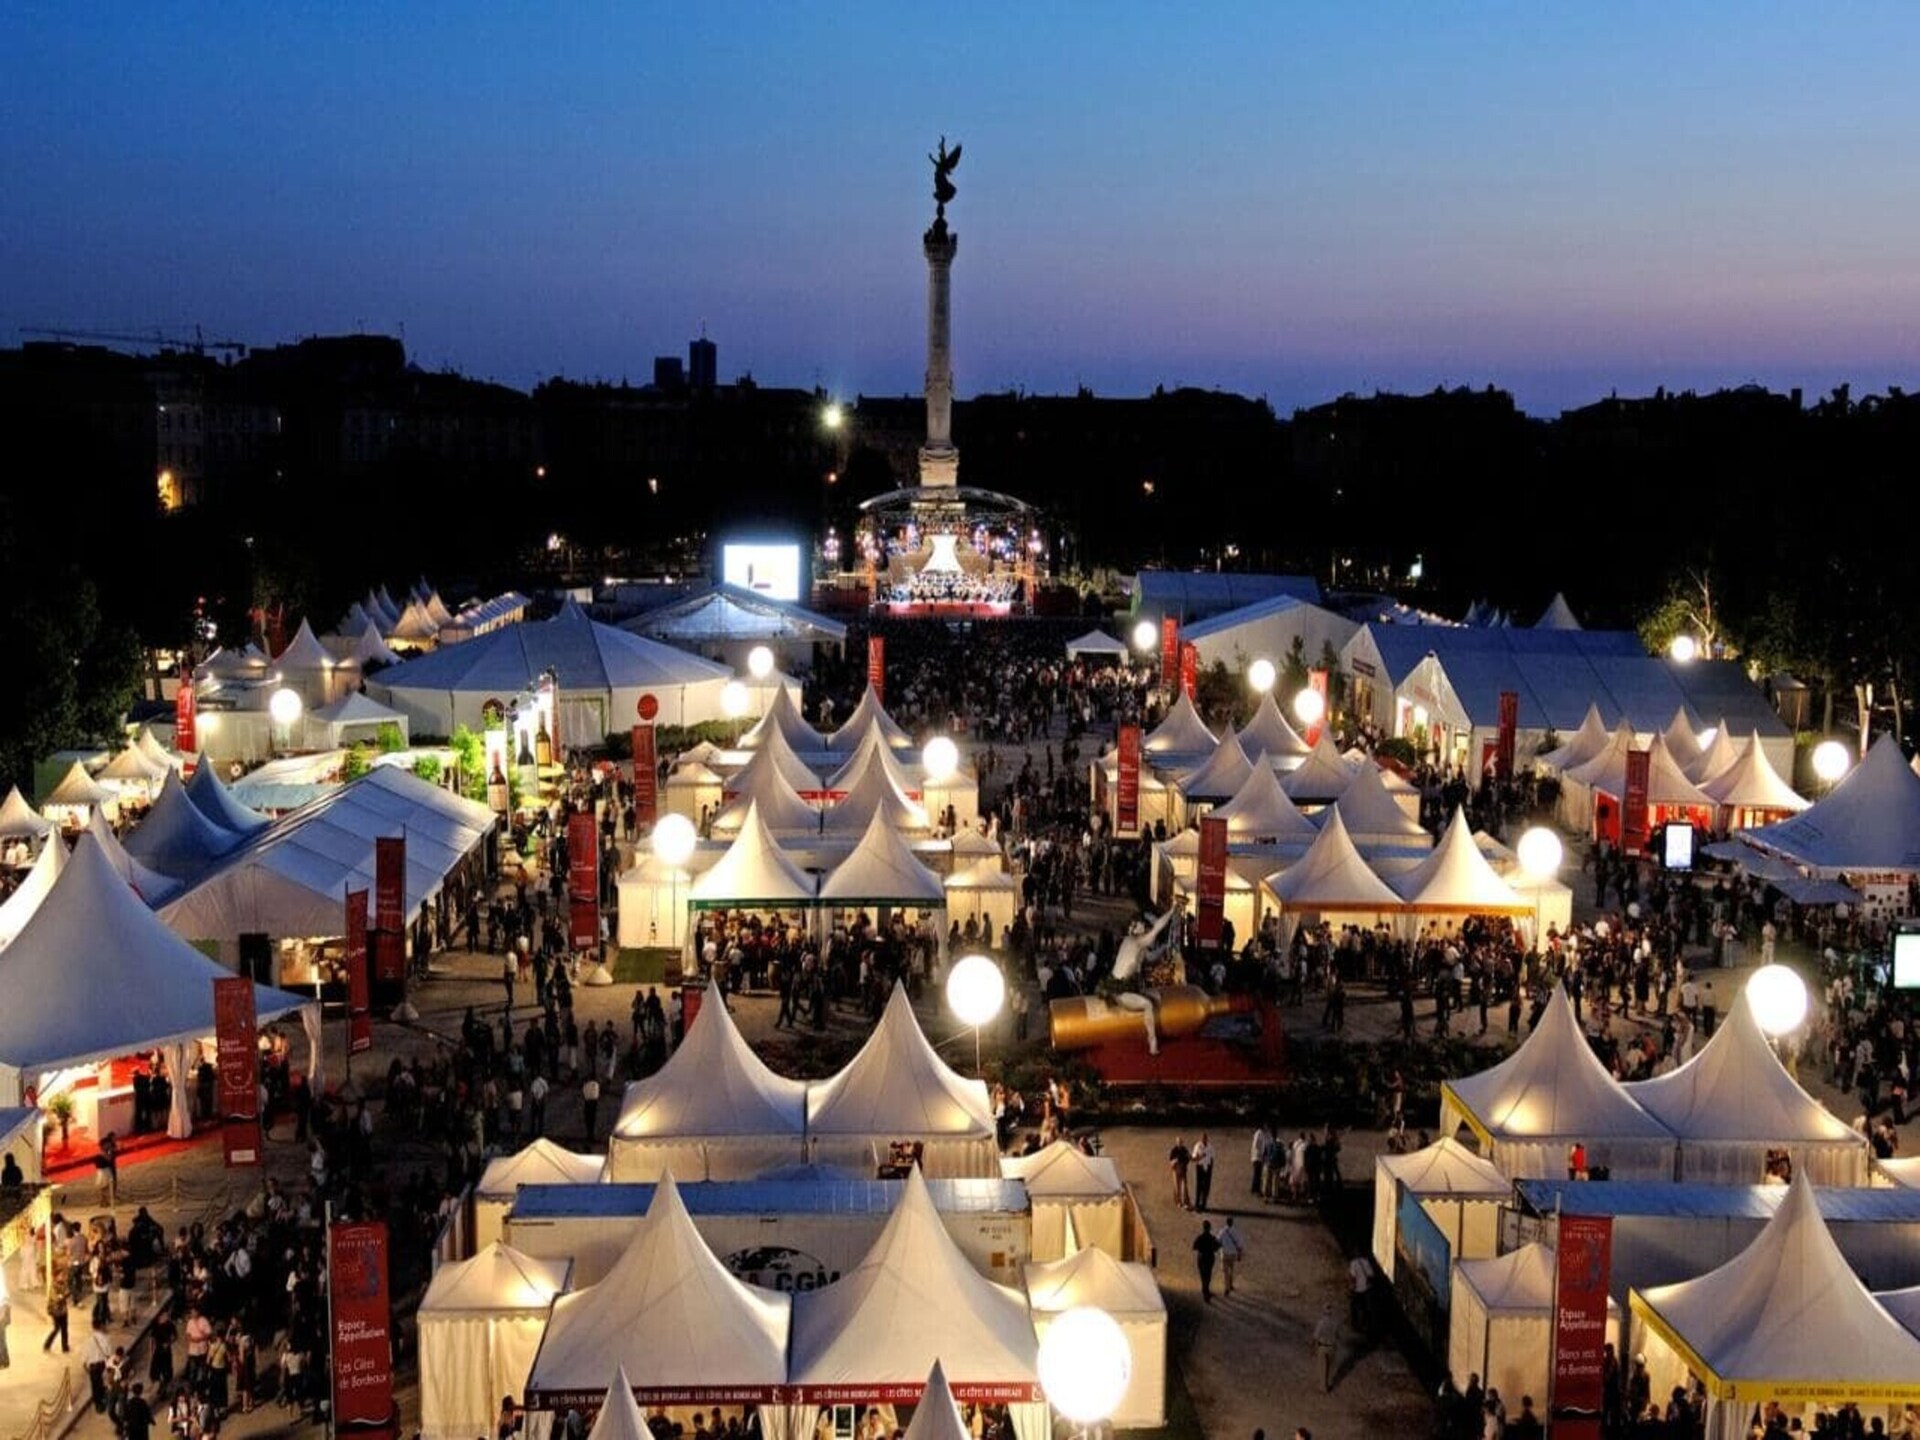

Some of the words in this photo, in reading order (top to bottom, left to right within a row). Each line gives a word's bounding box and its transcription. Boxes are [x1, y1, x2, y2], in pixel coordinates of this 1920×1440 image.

[338, 1321, 365, 1332] Espace
[339, 1328, 385, 1342] Appellation
[351, 1373, 387, 1388] Bordeaux
